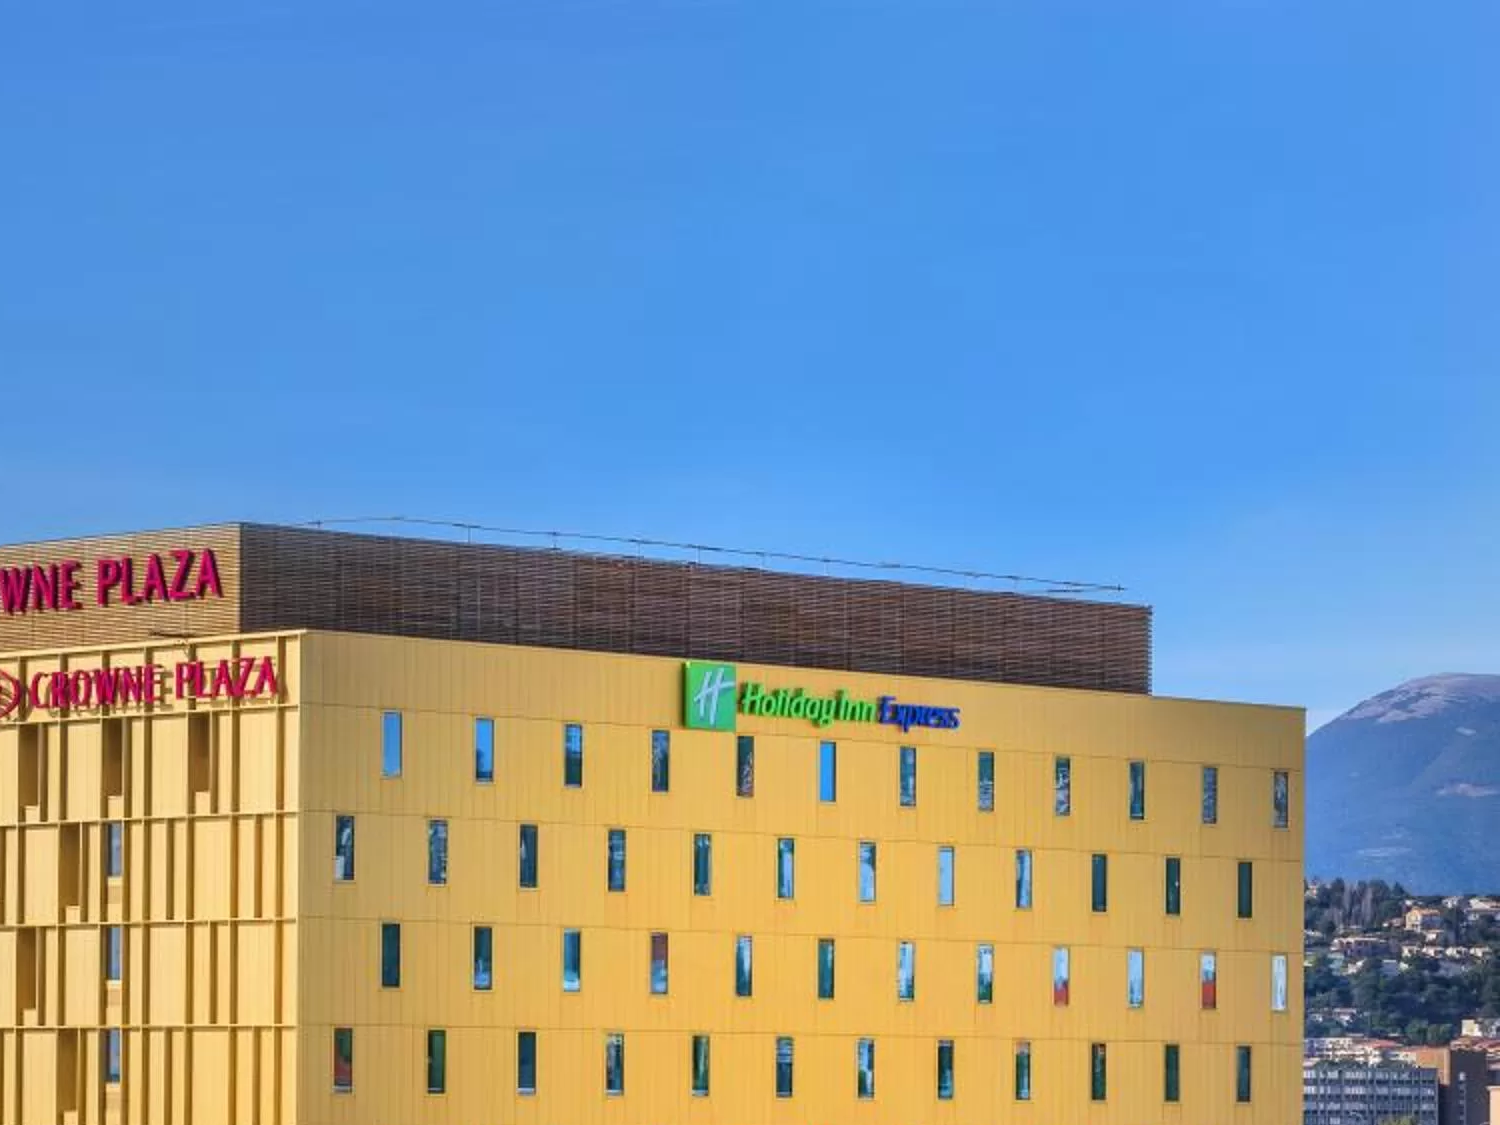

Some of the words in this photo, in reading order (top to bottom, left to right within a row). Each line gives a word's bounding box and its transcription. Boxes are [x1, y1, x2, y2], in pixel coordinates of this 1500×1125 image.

[96, 548, 223, 607] PLAZA
[30, 664, 162, 710] CROWNE
[175, 656, 279, 700] PLAZA
[740, 681, 837, 728] Holiday
[837, 688, 877, 724] Inn
[878, 696, 961, 733] Express
